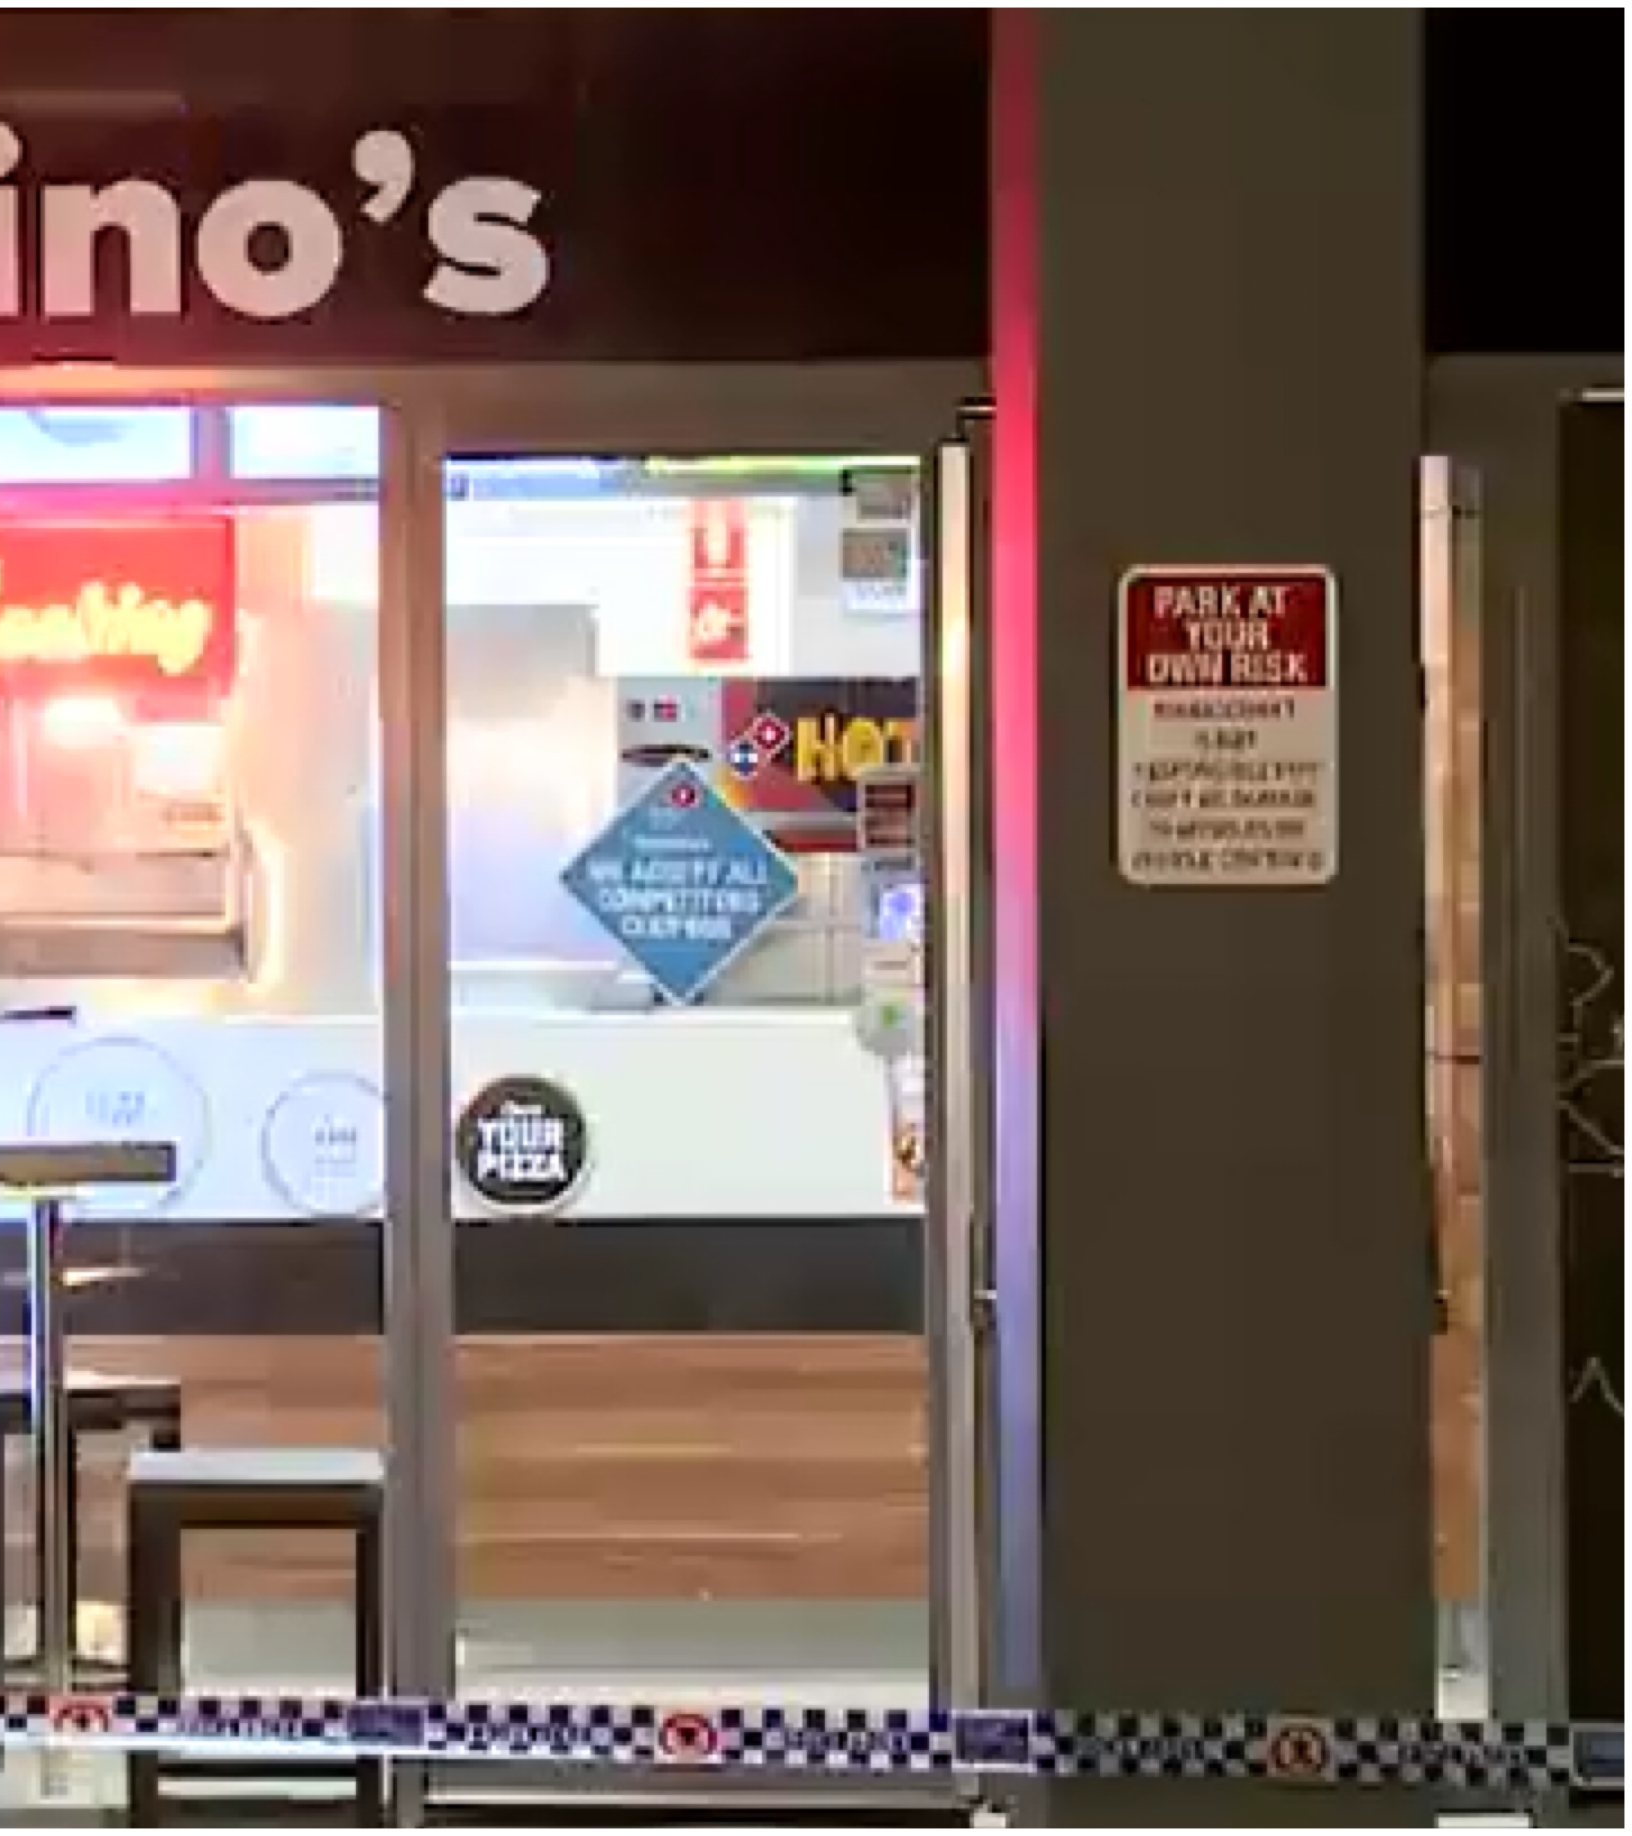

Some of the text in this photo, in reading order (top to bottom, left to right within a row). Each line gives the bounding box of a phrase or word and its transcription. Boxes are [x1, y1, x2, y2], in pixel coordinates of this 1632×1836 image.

[1153, 585, 1291, 617] PARK AT
[1187, 621, 1270, 651] YOUR
[1148, 653, 1309, 683] OWN RISK
[477, 1117, 564, 1153] YOUR
[477, 1153, 565, 1182] PIZZA
